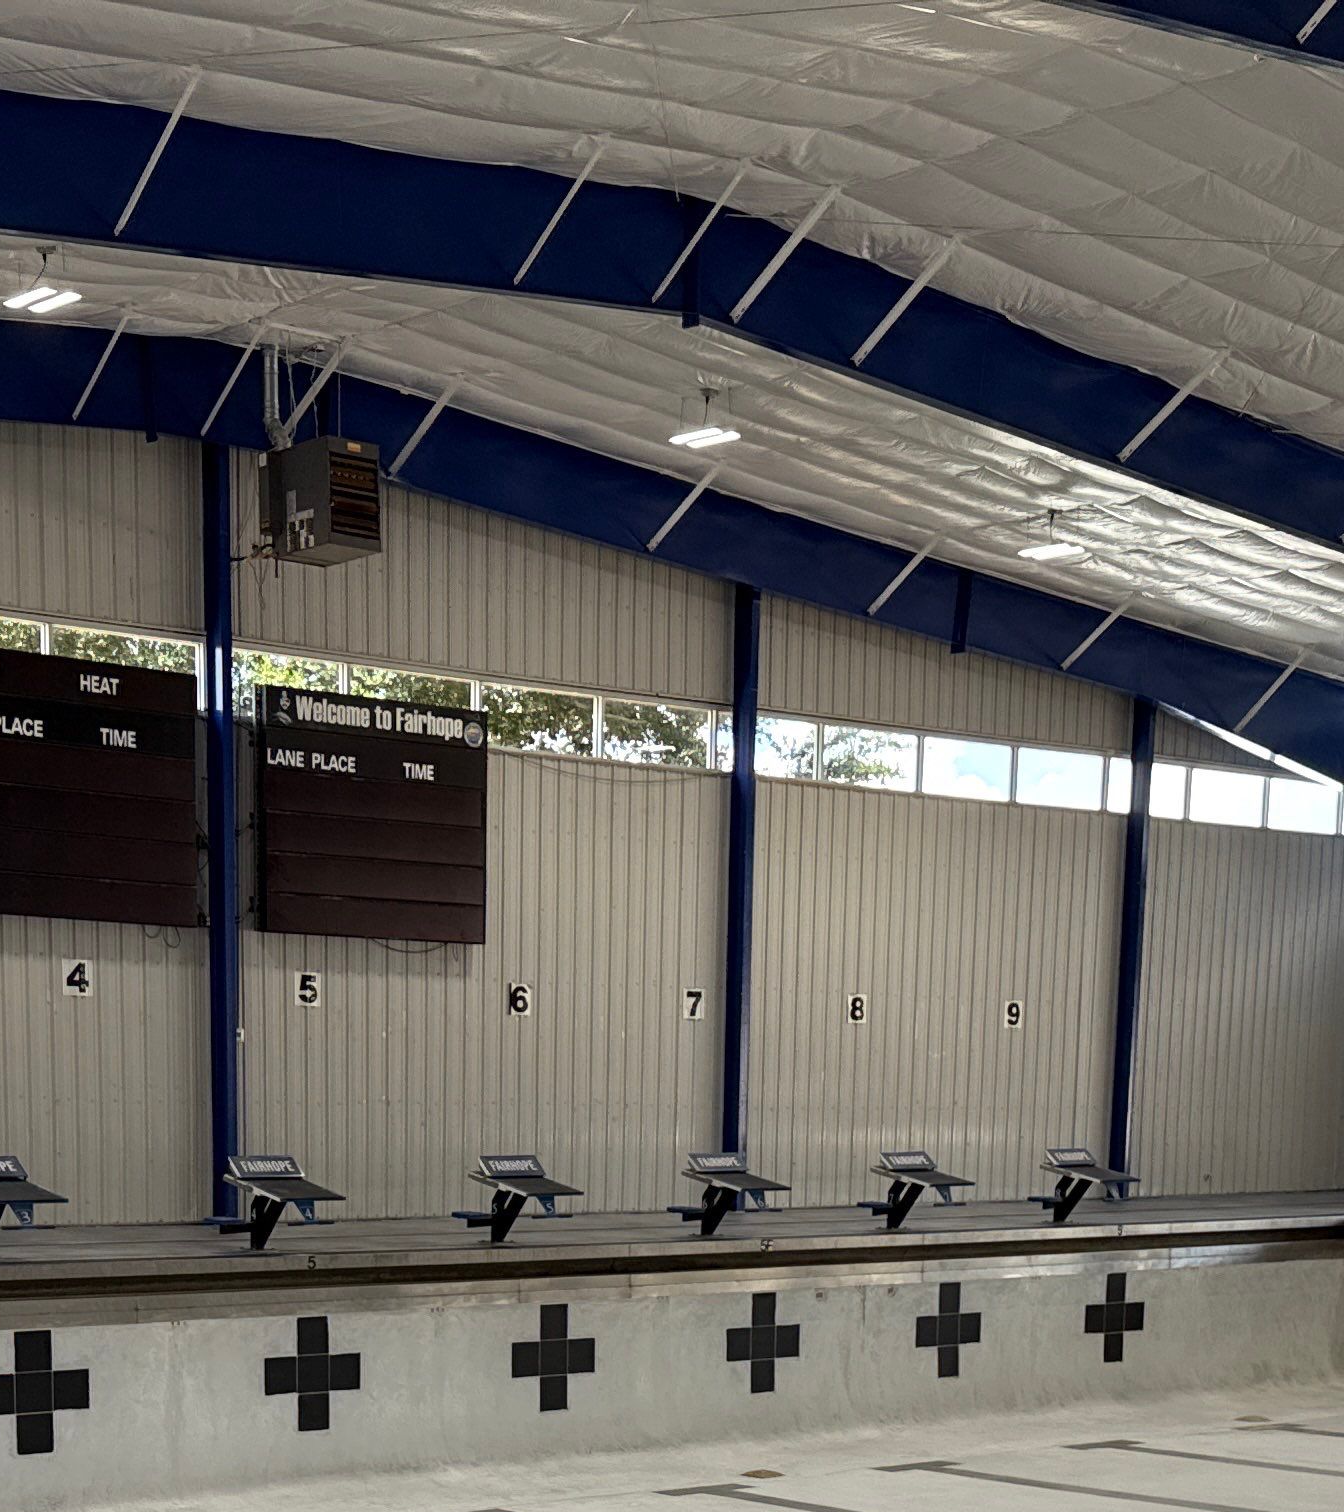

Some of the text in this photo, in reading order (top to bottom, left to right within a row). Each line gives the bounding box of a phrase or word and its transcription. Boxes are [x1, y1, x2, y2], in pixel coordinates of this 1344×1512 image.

[79, 673, 120, 696] HEAT
[295, 694, 371, 728] Welcome
[374, 705, 393, 732] to
[395, 707, 464, 742] Fairhope
[99, 727, 138, 749] TIME
[267, 747, 435, 782] LANE PLACE TIME
[66, 962, 90, 993] 4
[298, 974, 318, 1004] 5
[511, 985, 529, 1013] 6
[686, 990, 703, 1017] 7
[850, 996, 864, 1021] 8
[1007, 1002, 1021, 1026] 9
[239, 1160, 296, 1173] FAIRHOPE
[20, 1211, 31, 1224] 3
[305, 1208, 313, 1219] 4
[307, 1255, 317, 1270] 5
